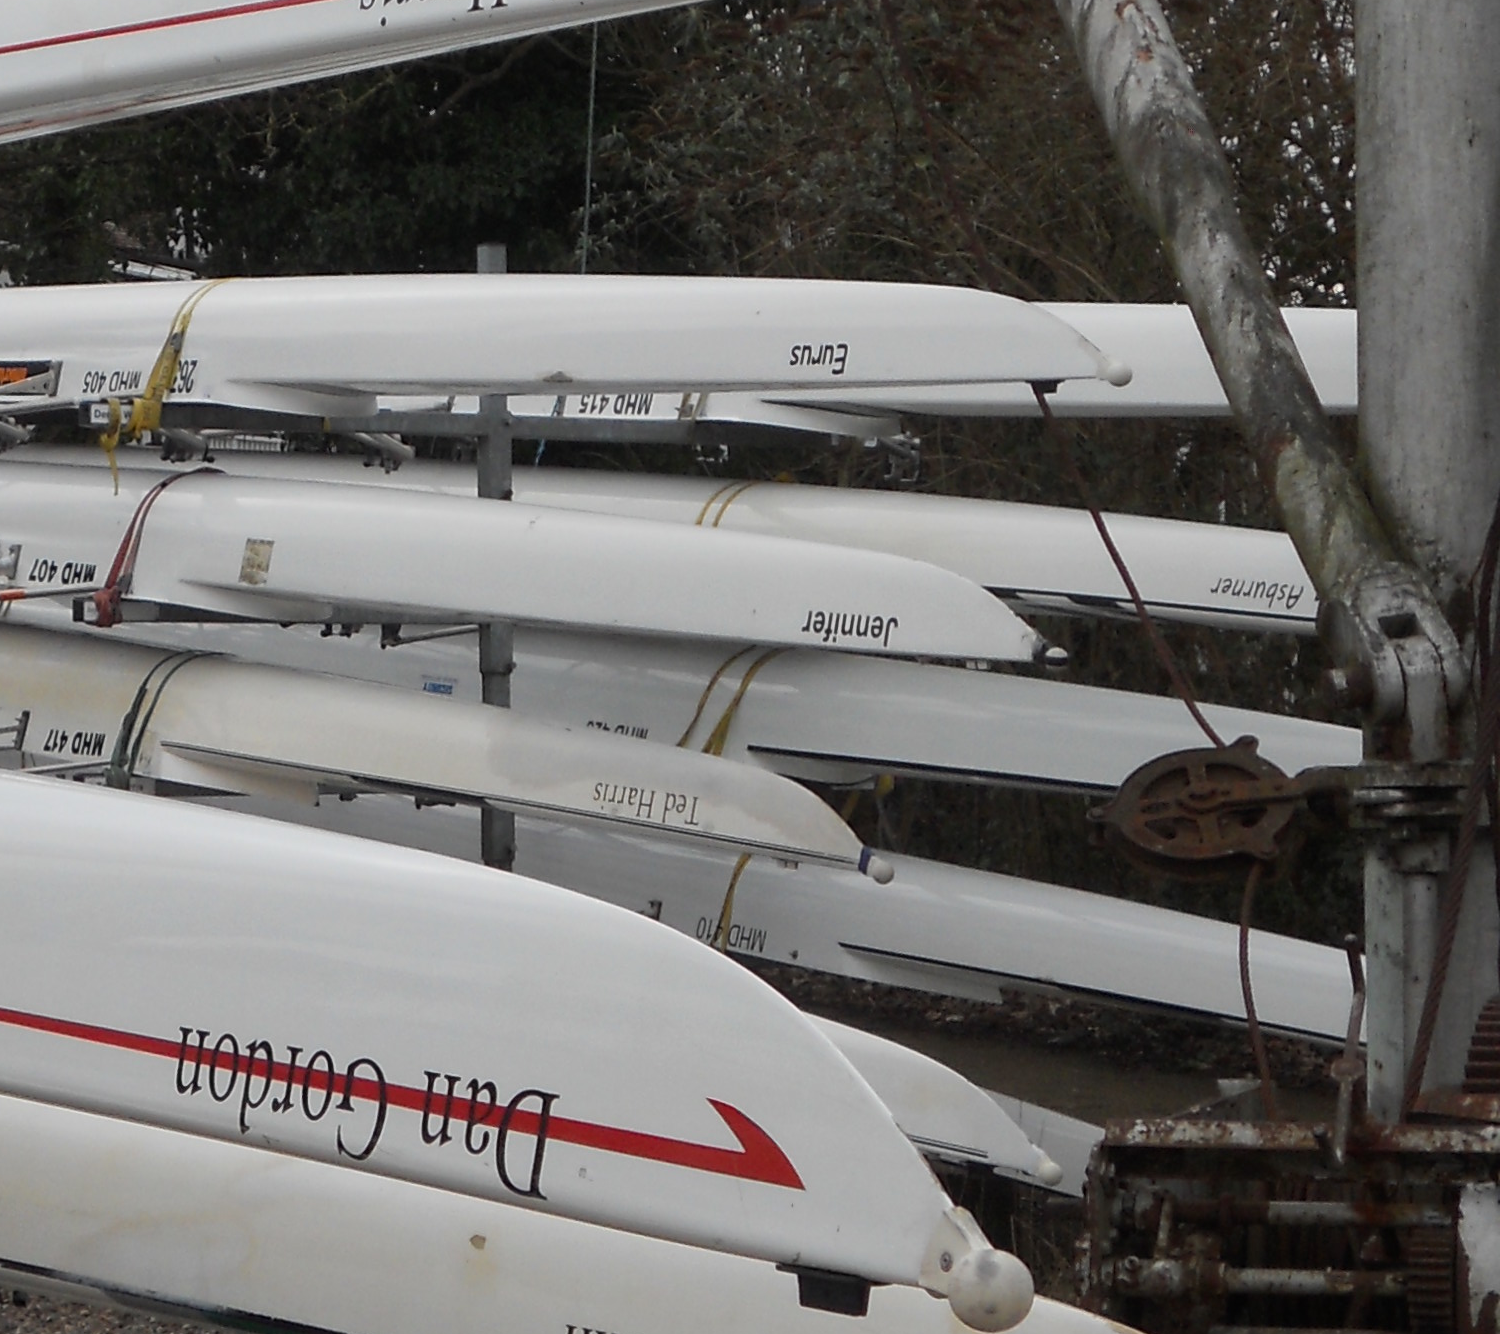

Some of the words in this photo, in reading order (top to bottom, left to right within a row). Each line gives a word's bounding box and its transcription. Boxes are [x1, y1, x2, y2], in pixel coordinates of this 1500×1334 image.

[789, 343, 849, 375] Eurus
[82, 370, 107, 394] 405
[110, 370, 142, 393] MHD
[579, 393, 610, 415] 415
[612, 393, 654, 416] MHD
[27, 558, 59, 585] 407
[61, 561, 97, 586] MHD
[1210, 577, 1305, 610] Asburner
[801, 607, 899, 647] Jennifer
[43, 728, 69, 755] 417
[71, 732, 107, 758] MHD
[591, 779, 654, 819] Harris
[663, 793, 699, 827] Ted
[728, 923, 768, 954] MHD
[174, 1025, 388, 1160] Gordon
[423, 1069, 560, 1200] Dan
